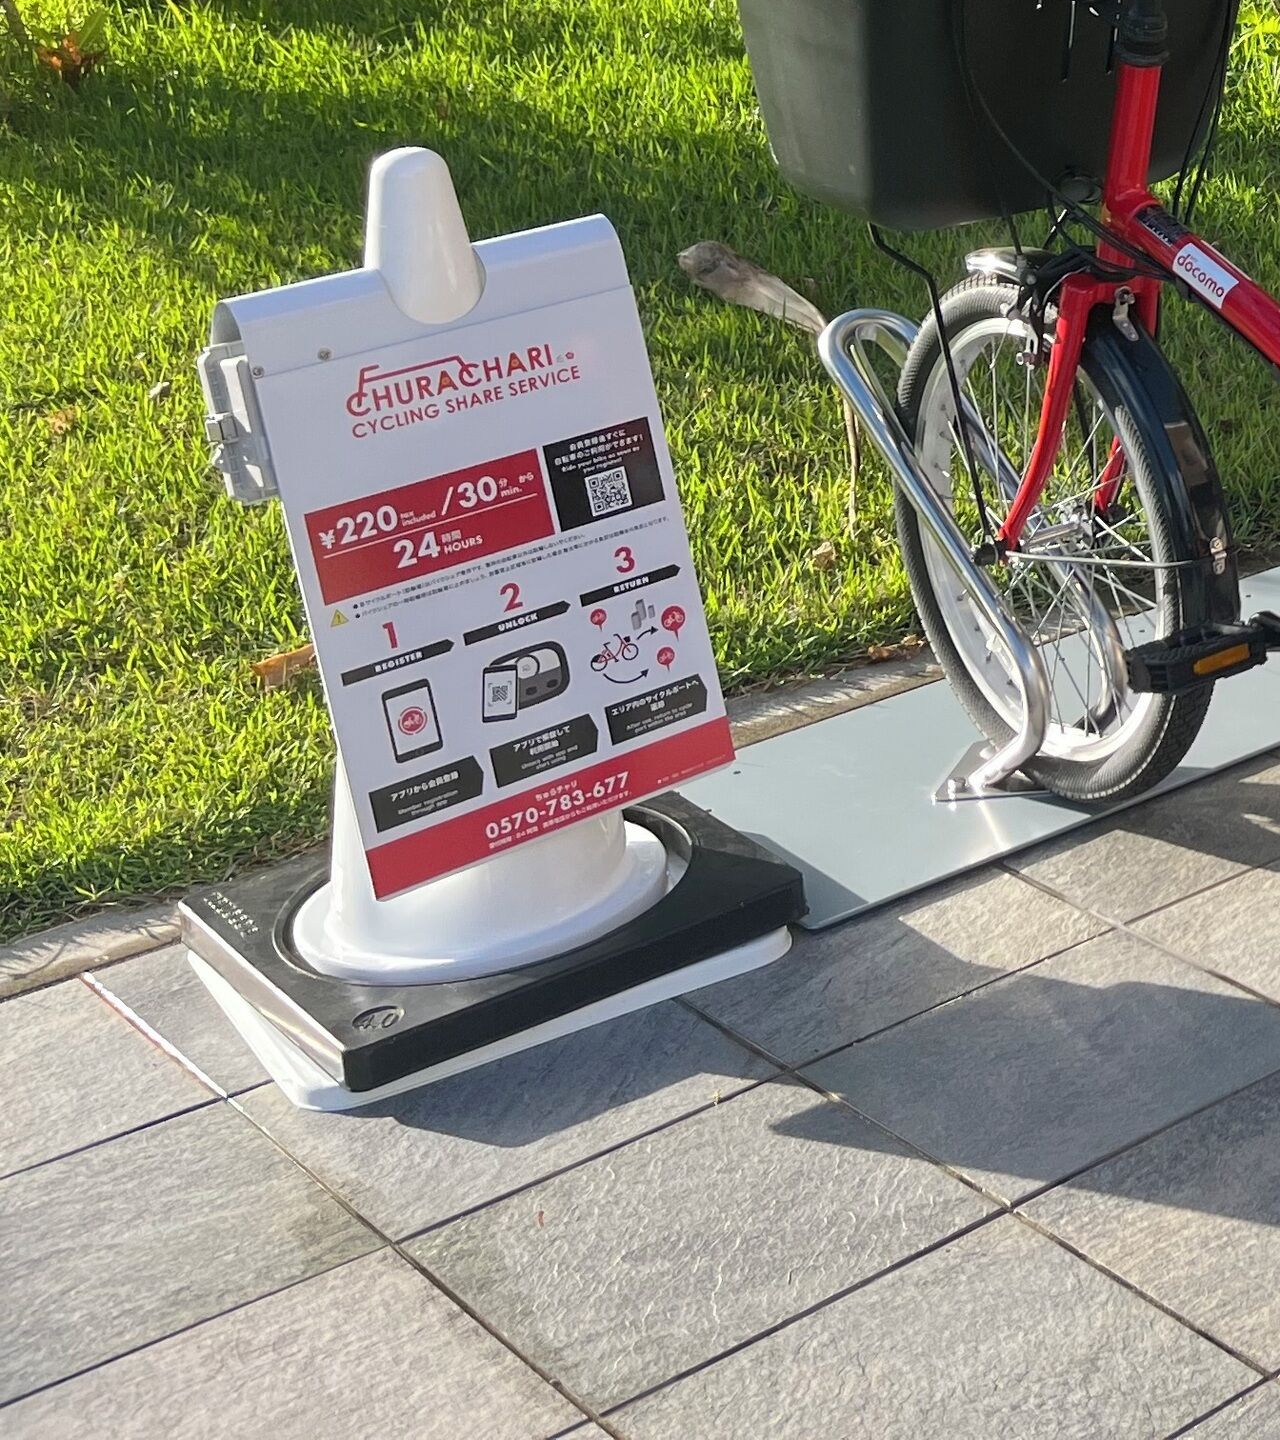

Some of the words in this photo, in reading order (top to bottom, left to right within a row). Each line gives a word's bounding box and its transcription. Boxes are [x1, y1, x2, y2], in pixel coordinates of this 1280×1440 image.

[1177, 254, 1224, 298] docomo
[346, 344, 553, 417] CHURACHARI
[352, 403, 440, 438] CYCLING
[446, 386, 504, 414] SHARE
[509, 365, 581, 396] SERVICE
[500, 487, 523, 498] min.
[318, 505, 398, 549] ¥220
[393, 531, 441, 568] 24
[443, 535, 483, 555] HOURS
[614, 546, 635, 573] 3
[500, 582, 523, 612] 2
[613, 576, 649, 593] RETURN
[382, 621, 398, 649] 1
[498, 613, 538, 632] UNLOCK
[374, 651, 423, 673] REGISTER
[485, 771, 629, 839] 0570-783-677
